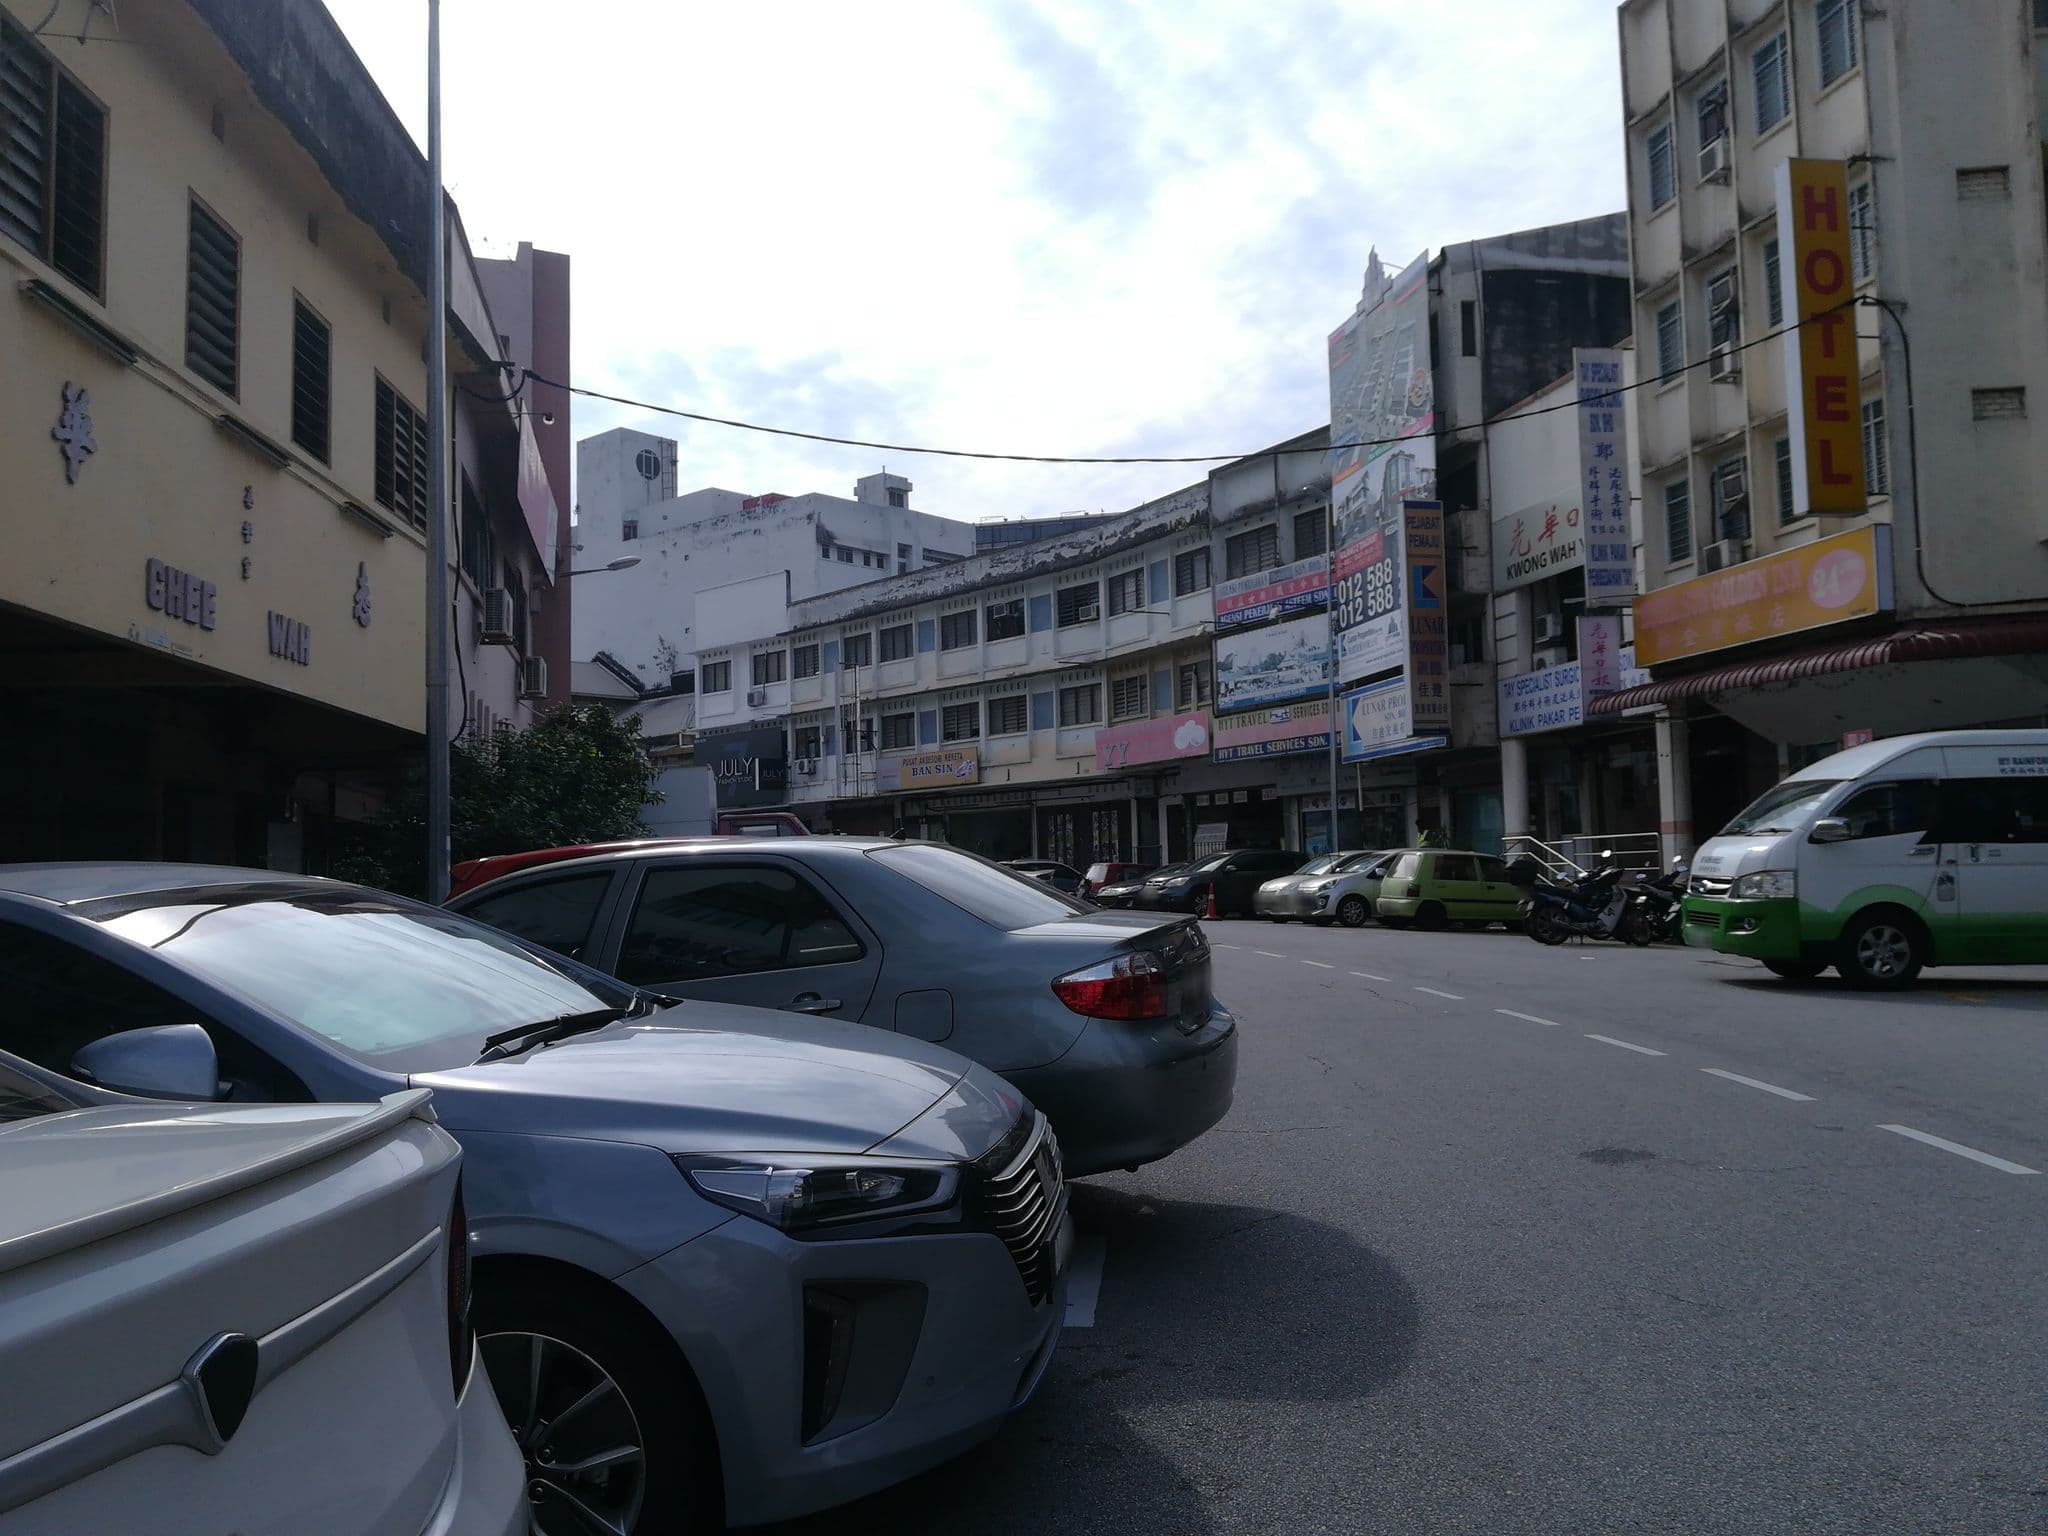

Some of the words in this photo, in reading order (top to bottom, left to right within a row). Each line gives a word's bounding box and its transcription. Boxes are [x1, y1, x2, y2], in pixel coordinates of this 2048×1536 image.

[1801, 185, 1854, 486] HOTEL
[1506, 552, 1547, 580] KWONG
[1550, 541, 1576, 565] WAH
[1338, 572, 1362, 603] 012
[1367, 558, 1392, 591] 588
[146, 557, 217, 631] CHEE
[1339, 597, 1363, 628] 012
[1367, 583, 1393, 616] 588
[268, 609, 311, 665] WAH
[1517, 672, 1552, 696] SPECIALIST
[1293, 704, 1320, 719] SERVICES
[1362, 698, 1386, 716] LUNAR
[1218, 717, 1233, 731] HYT
[1236, 711, 1267, 729] TRAVEL
[1509, 716, 1535, 732] KLINIK
[1537, 709, 1565, 726] PAKAR
[1219, 748, 1233, 760] HYT
[1237, 745, 1265, 757] TRAVEL
[1267, 738, 1305, 753] SERVICES
[719, 757, 752, 778] JULY
[902, 757, 917, 767] PUSAT
[912, 766, 932, 777] BAN
[935, 764, 953, 775] SIN
